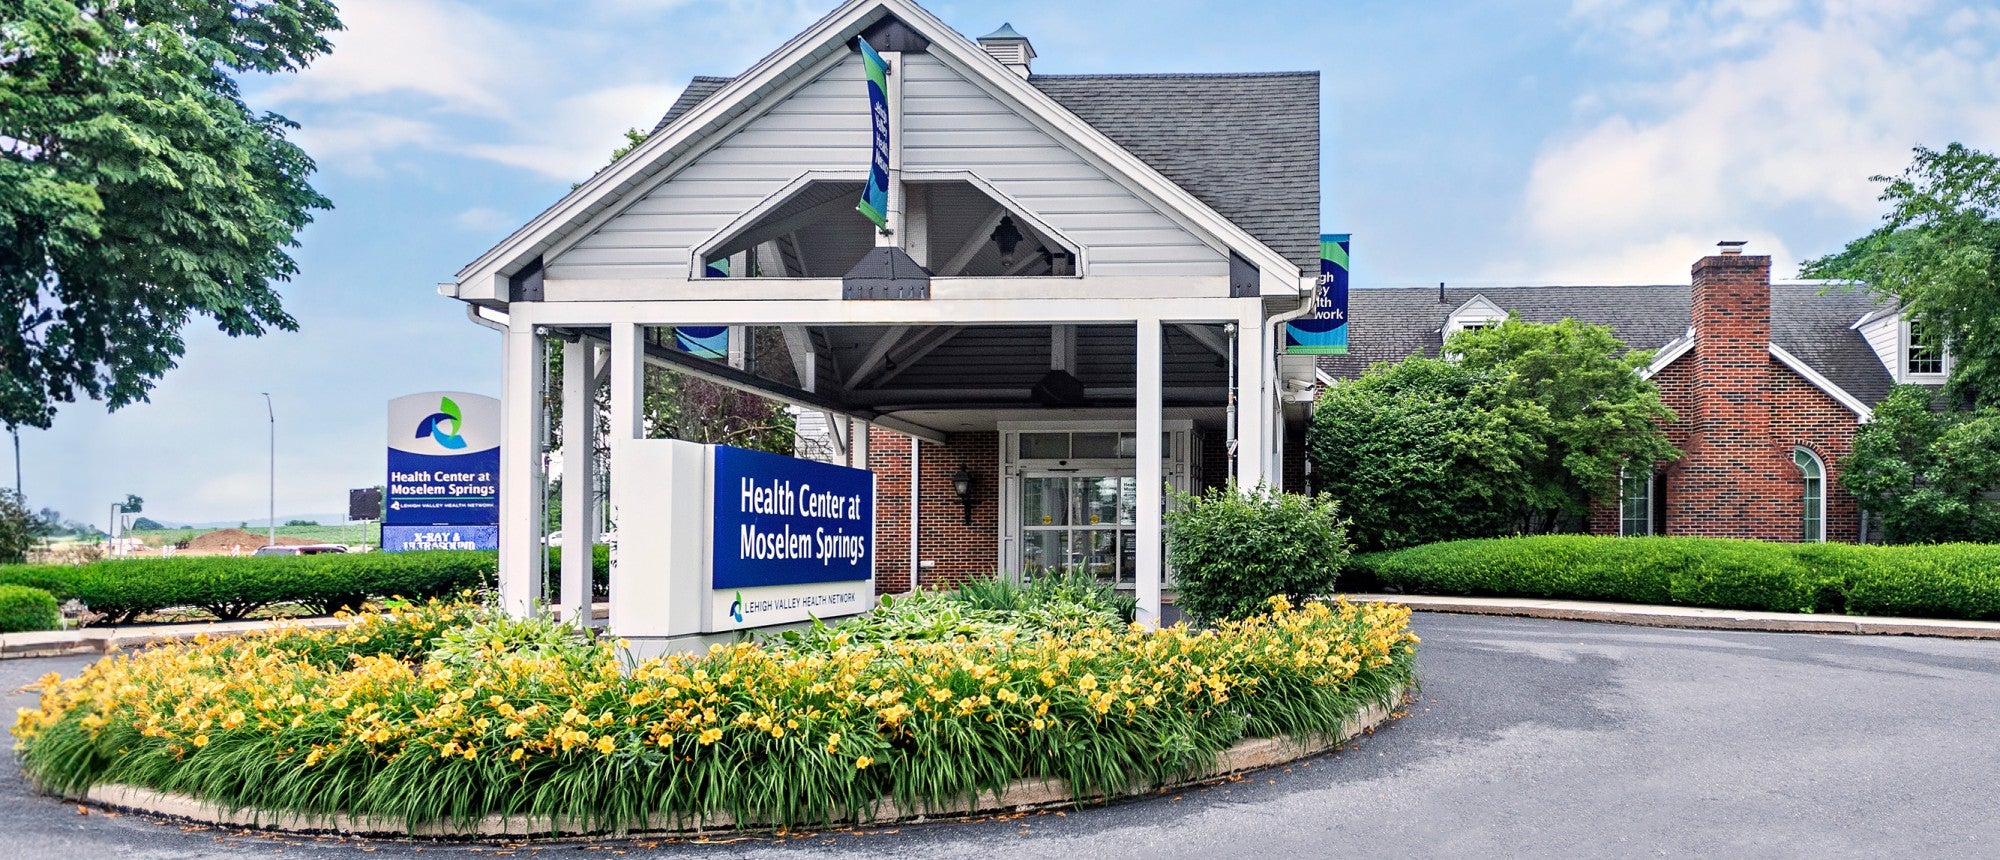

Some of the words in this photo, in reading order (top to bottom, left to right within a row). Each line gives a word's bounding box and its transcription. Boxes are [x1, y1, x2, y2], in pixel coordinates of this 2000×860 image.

[391, 471, 431, 482] Health
[434, 471, 475, 482] Center
[478, 472, 490, 482] at
[391, 484, 446, 494] Moselem
[448, 484, 495, 496] Springs
[741, 476, 795, 516] Health
[799, 483, 845, 519] Center
[848, 494, 861, 520] at
[414, 532, 451, 542] X-RAY
[740, 523, 812, 560] Moselem
[816, 526, 865, 566] Springs
[745, 600, 773, 614] LEHIGH
[775, 597, 800, 610] VALLEY
[802, 594, 827, 607] HEALTH
[828, 592, 856, 605] NETWORK
